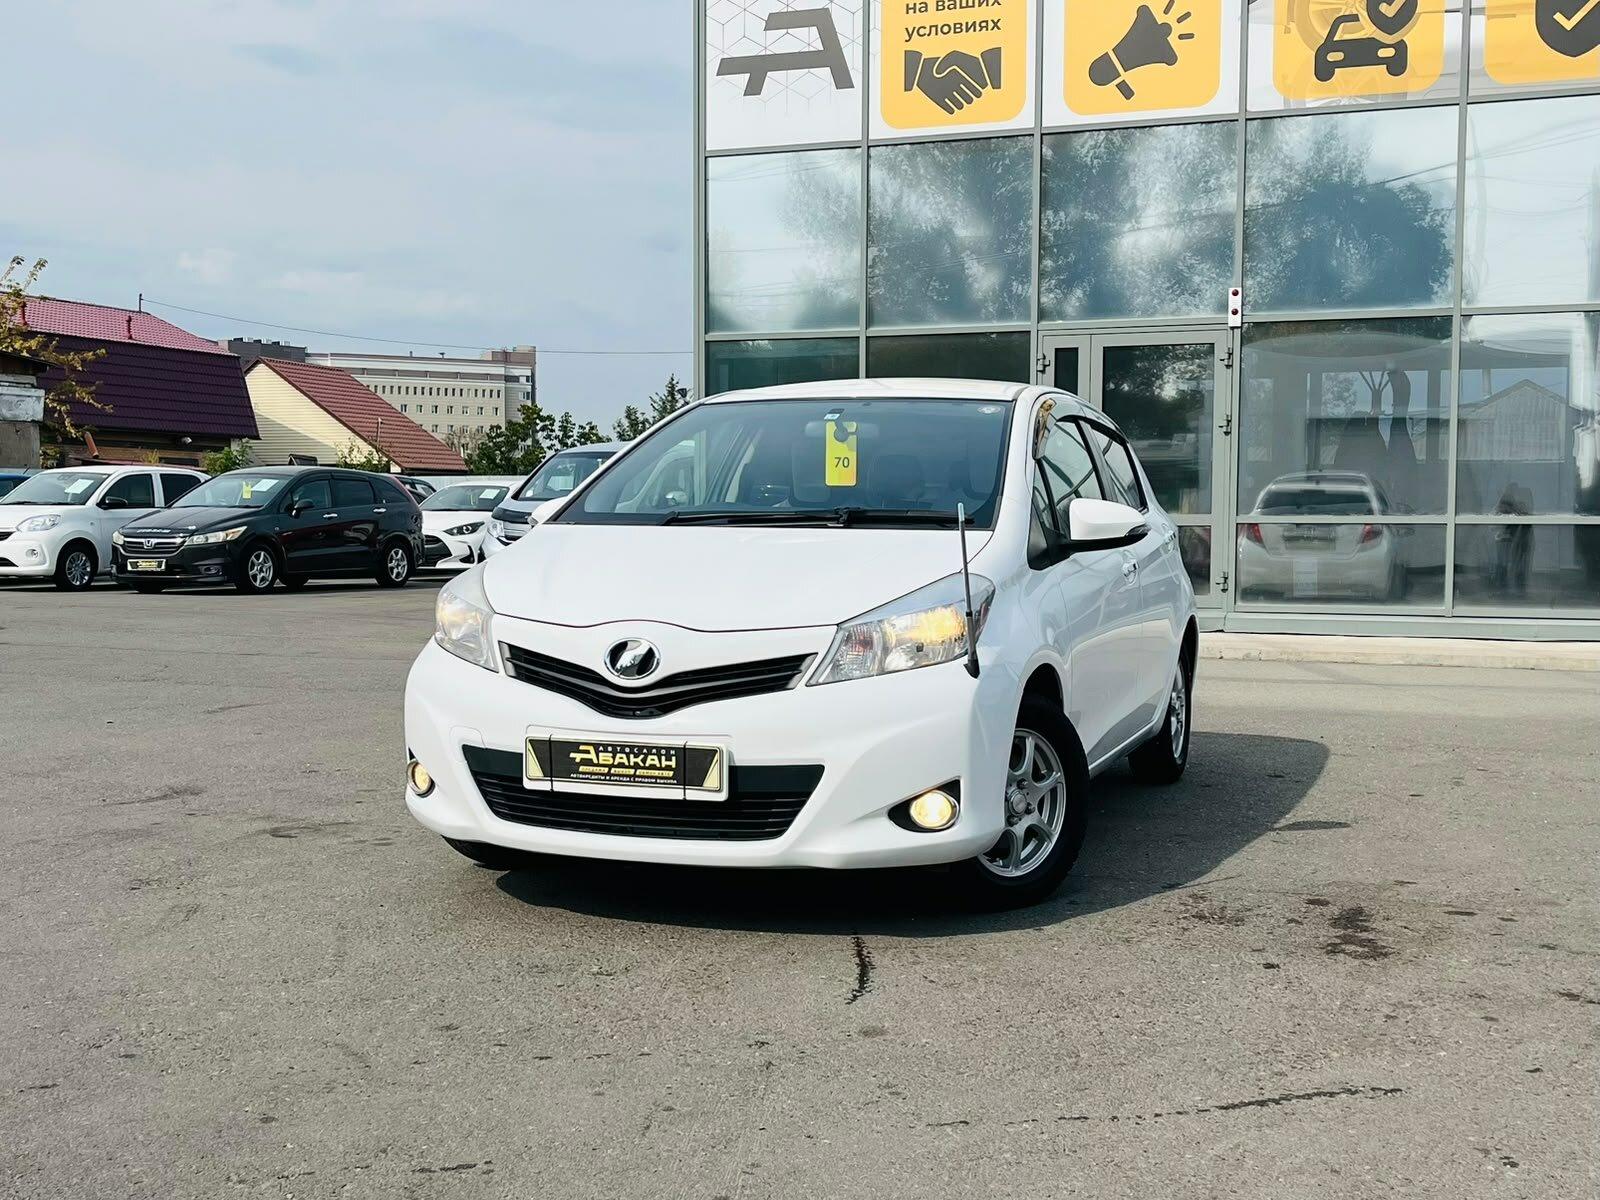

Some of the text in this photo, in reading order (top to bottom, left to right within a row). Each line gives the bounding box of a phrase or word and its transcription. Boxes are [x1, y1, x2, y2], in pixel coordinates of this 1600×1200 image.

[905, 1, 928, 15] на
[904, 18, 1002, 43] условиях
[834, 456, 850, 468] 70
[569, 745, 676, 769] АБАКАН
[598, 746, 676, 755] АВТОСАЛОН
